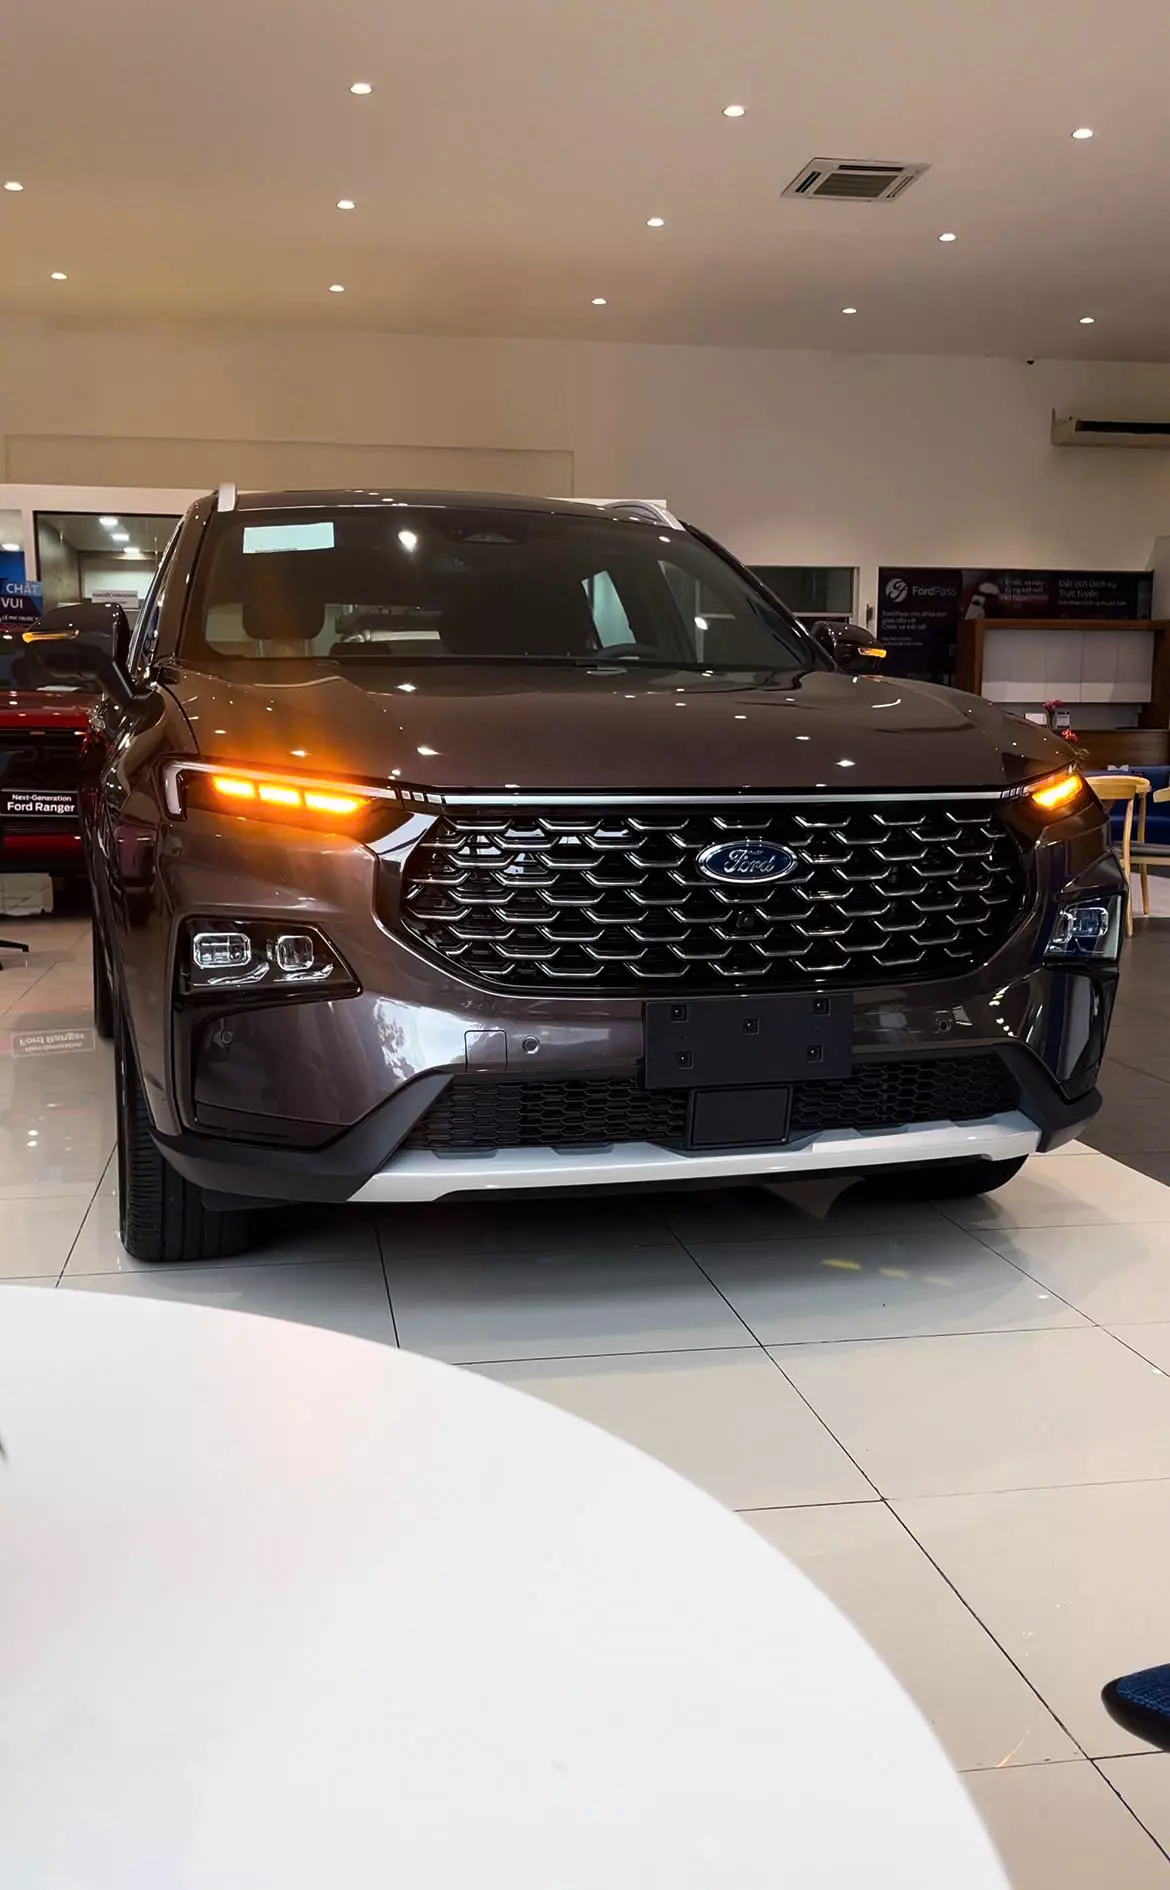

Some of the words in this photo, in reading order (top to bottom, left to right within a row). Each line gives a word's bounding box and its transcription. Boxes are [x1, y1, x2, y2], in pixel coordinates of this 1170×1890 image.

[912, 585, 957, 596] FordPass
[1, 597, 23, 608] VUI
[12, 794, 72, 802] Next-Generation
[7, 802, 33, 811] Ford
[35, 802, 75, 814] Ranger
[723, 849, 776, 873] Ford
